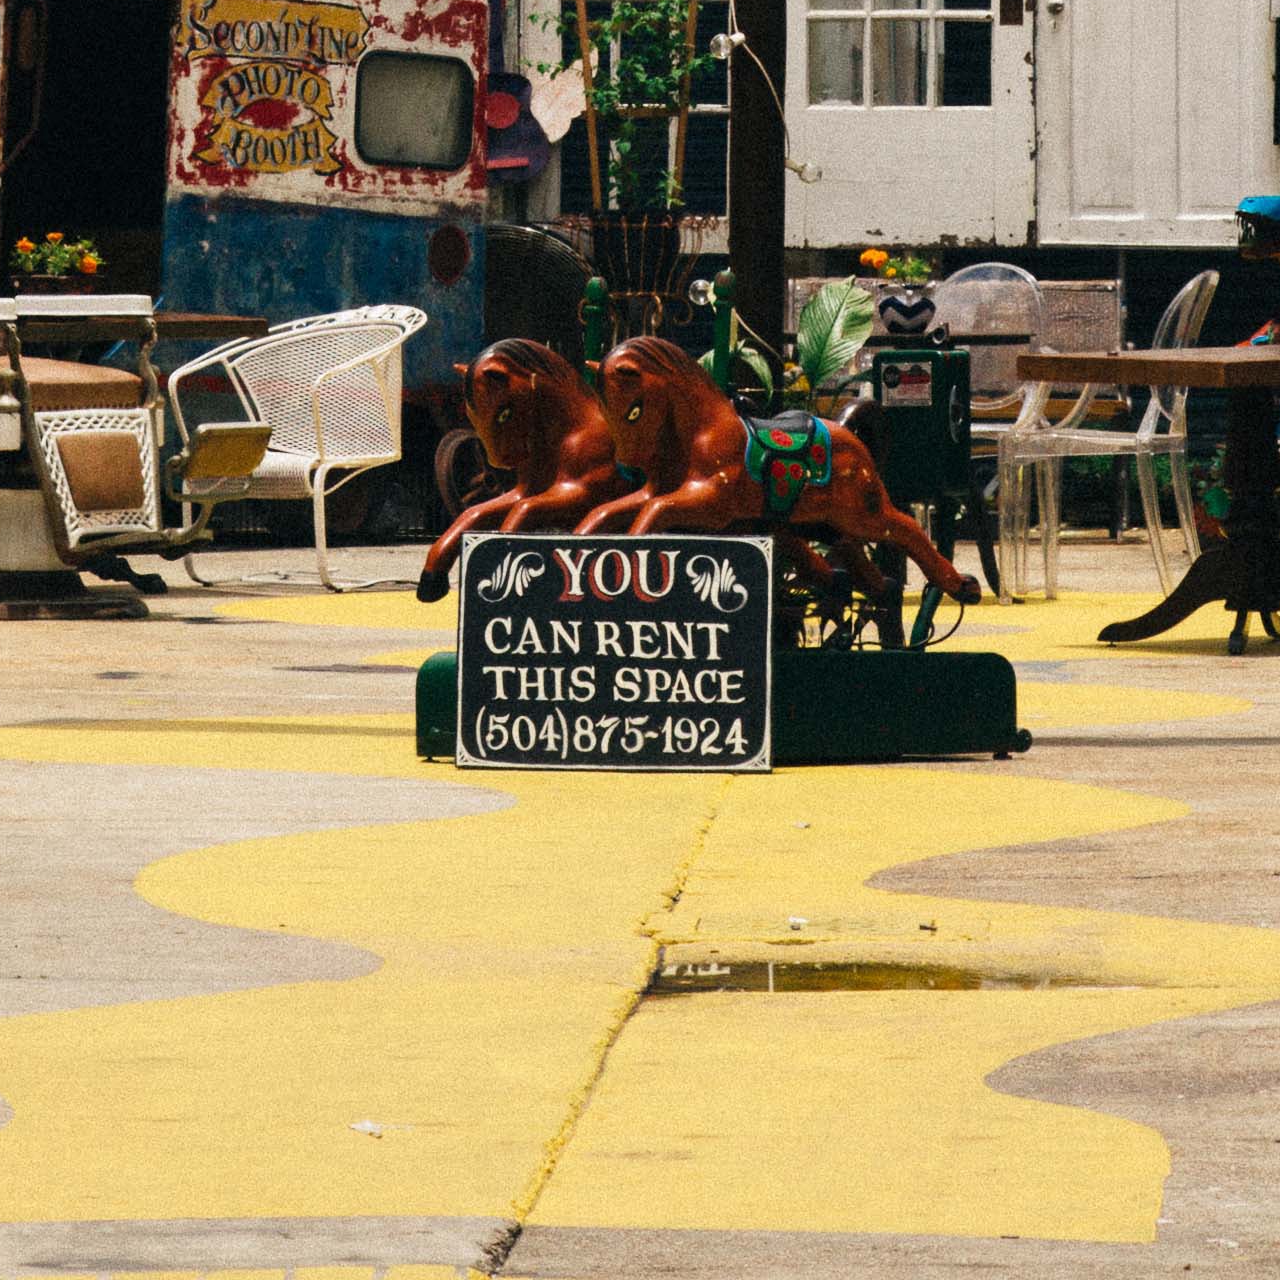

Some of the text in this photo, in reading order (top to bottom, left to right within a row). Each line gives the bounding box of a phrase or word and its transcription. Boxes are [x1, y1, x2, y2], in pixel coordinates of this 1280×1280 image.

[217, 63, 320, 117] PHOTO
[222, 126, 324, 168] BOOTH
[552, 548, 680, 602] YOU
[484, 616, 730, 661] CAN RENT
[482, 665, 746, 704] THIS SPACE
